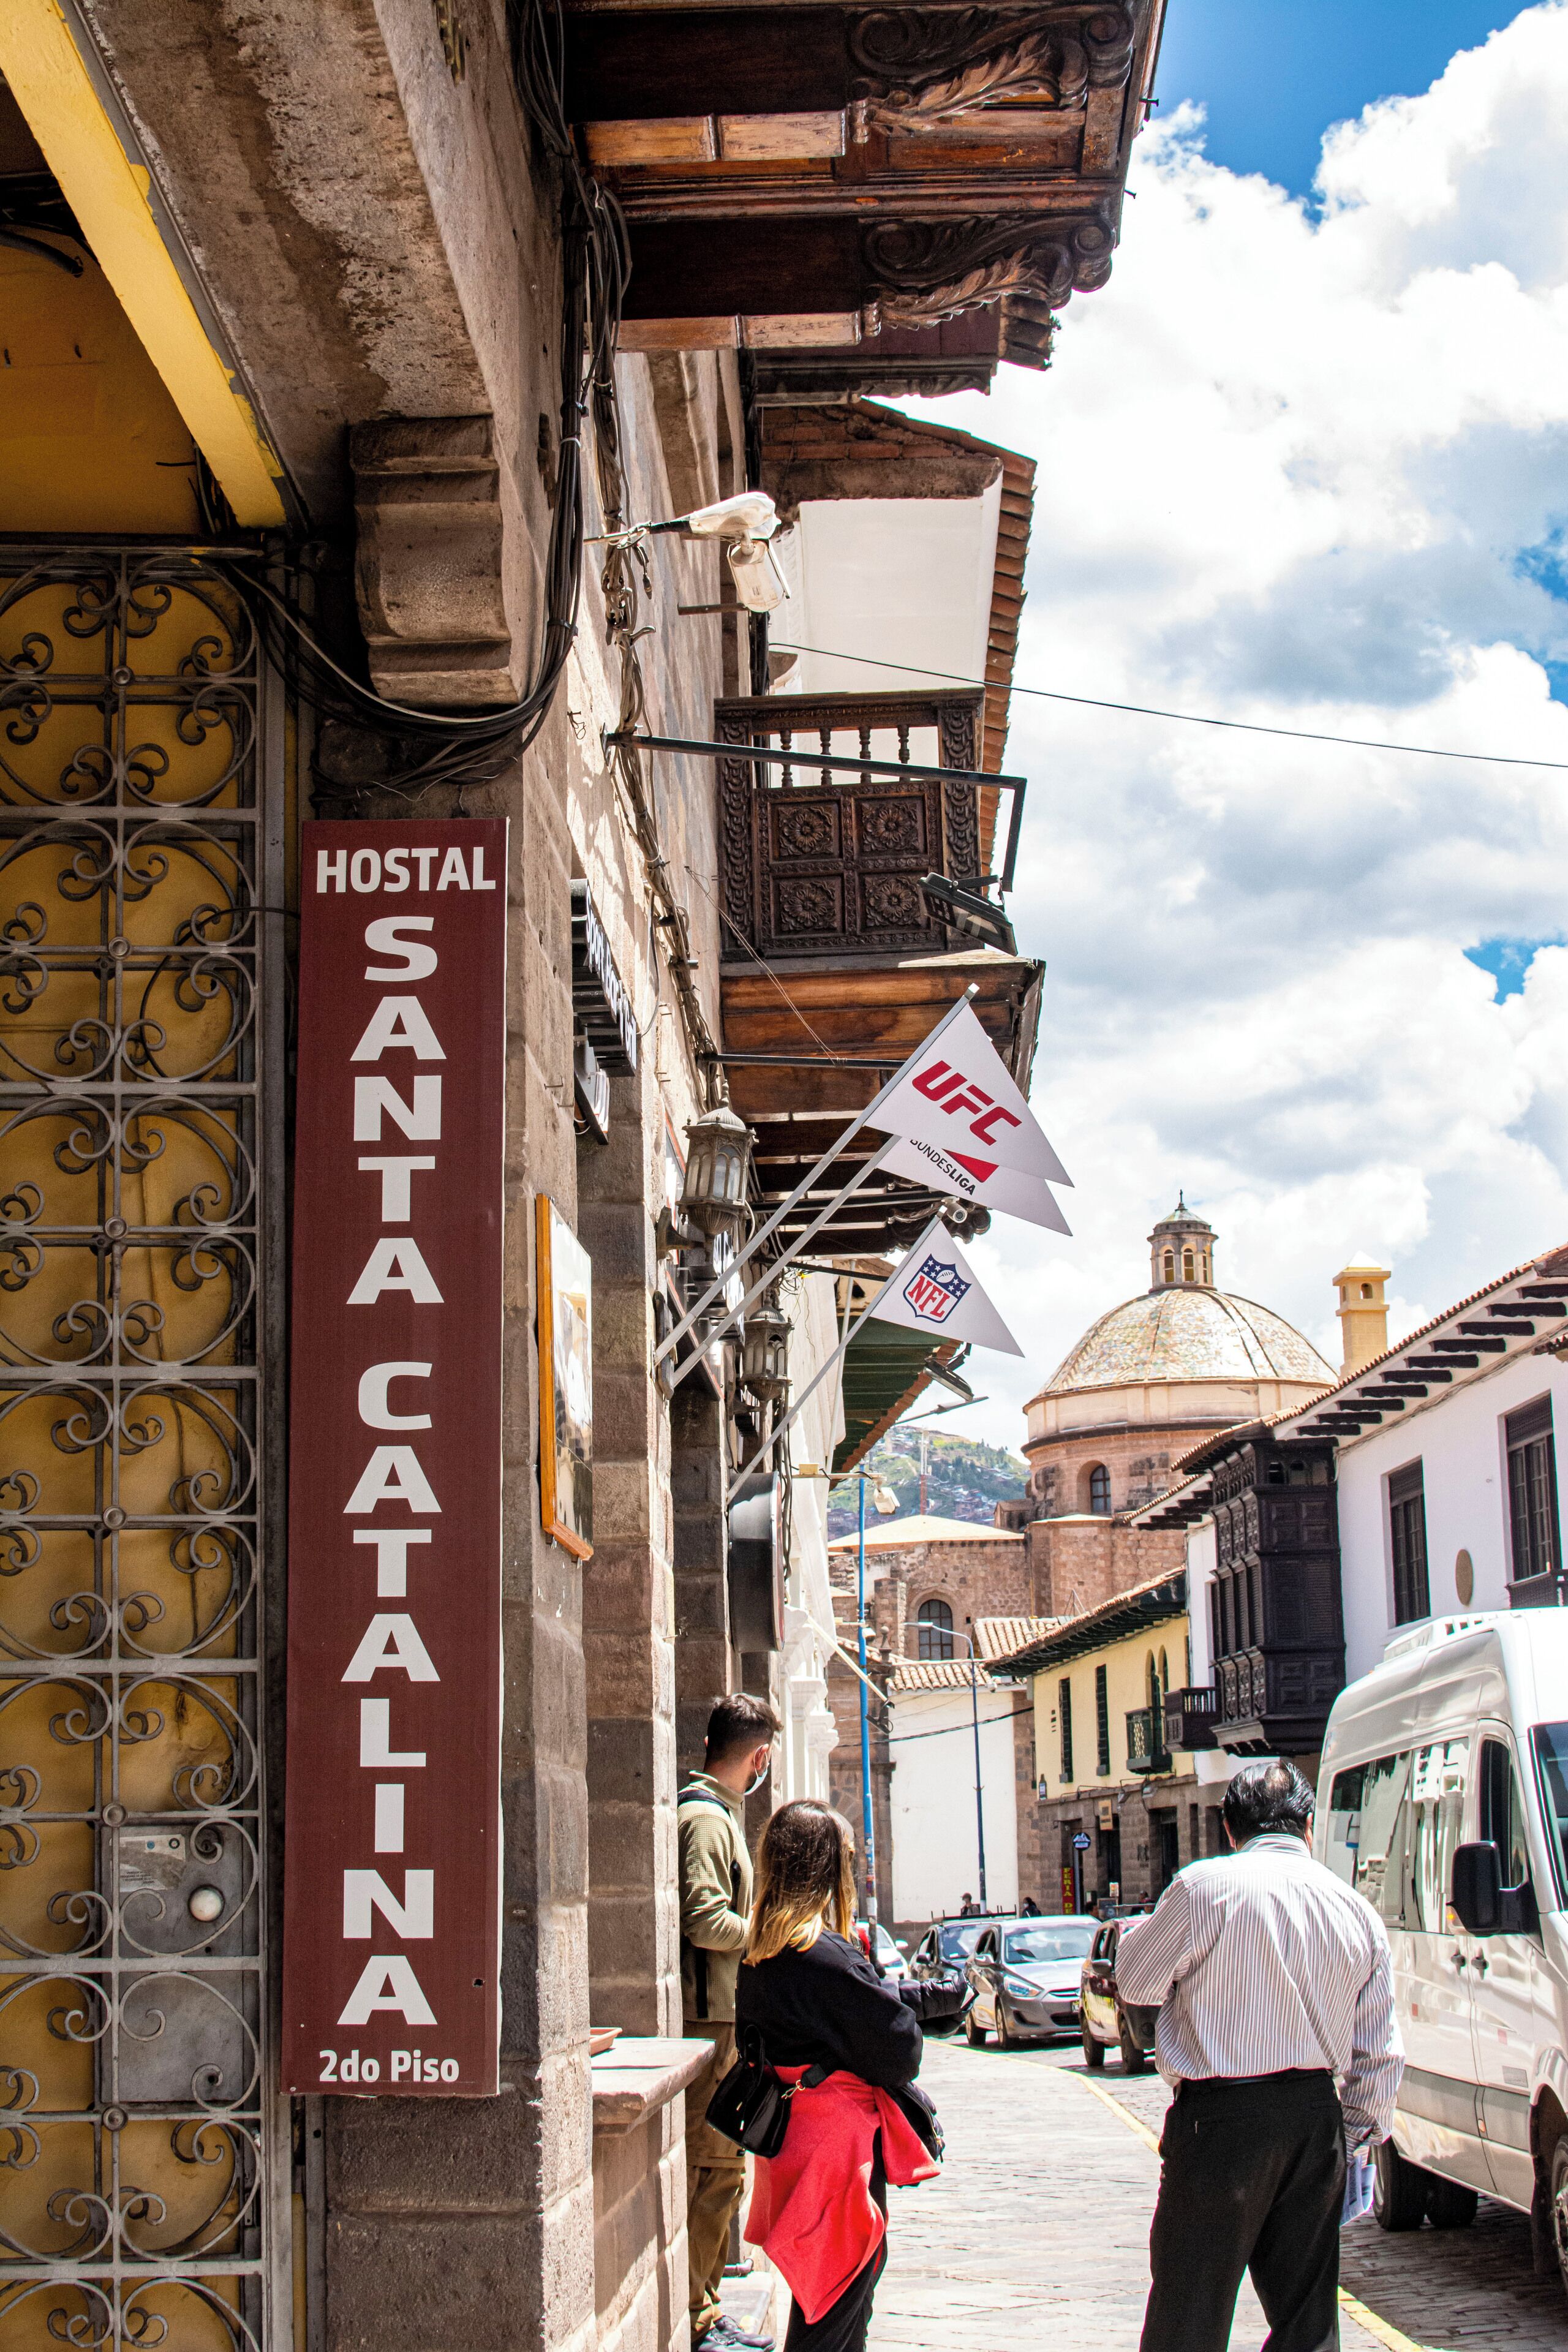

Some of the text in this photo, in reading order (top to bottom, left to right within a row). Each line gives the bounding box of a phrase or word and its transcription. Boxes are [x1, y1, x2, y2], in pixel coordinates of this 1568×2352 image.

[316, 846, 496, 893] HOSTAL
[586, 885, 604, 983] Sport
[606, 941, 620, 1017] Bar
[912, 1060, 1022, 1146] UFC
[908, 1275, 951, 1318] NFL
[333, 916, 447, 2026] SANTA CATALINA
[1063, 1868, 1072, 1896] FERIA
[319, 2049, 459, 2082] 2do Piso
